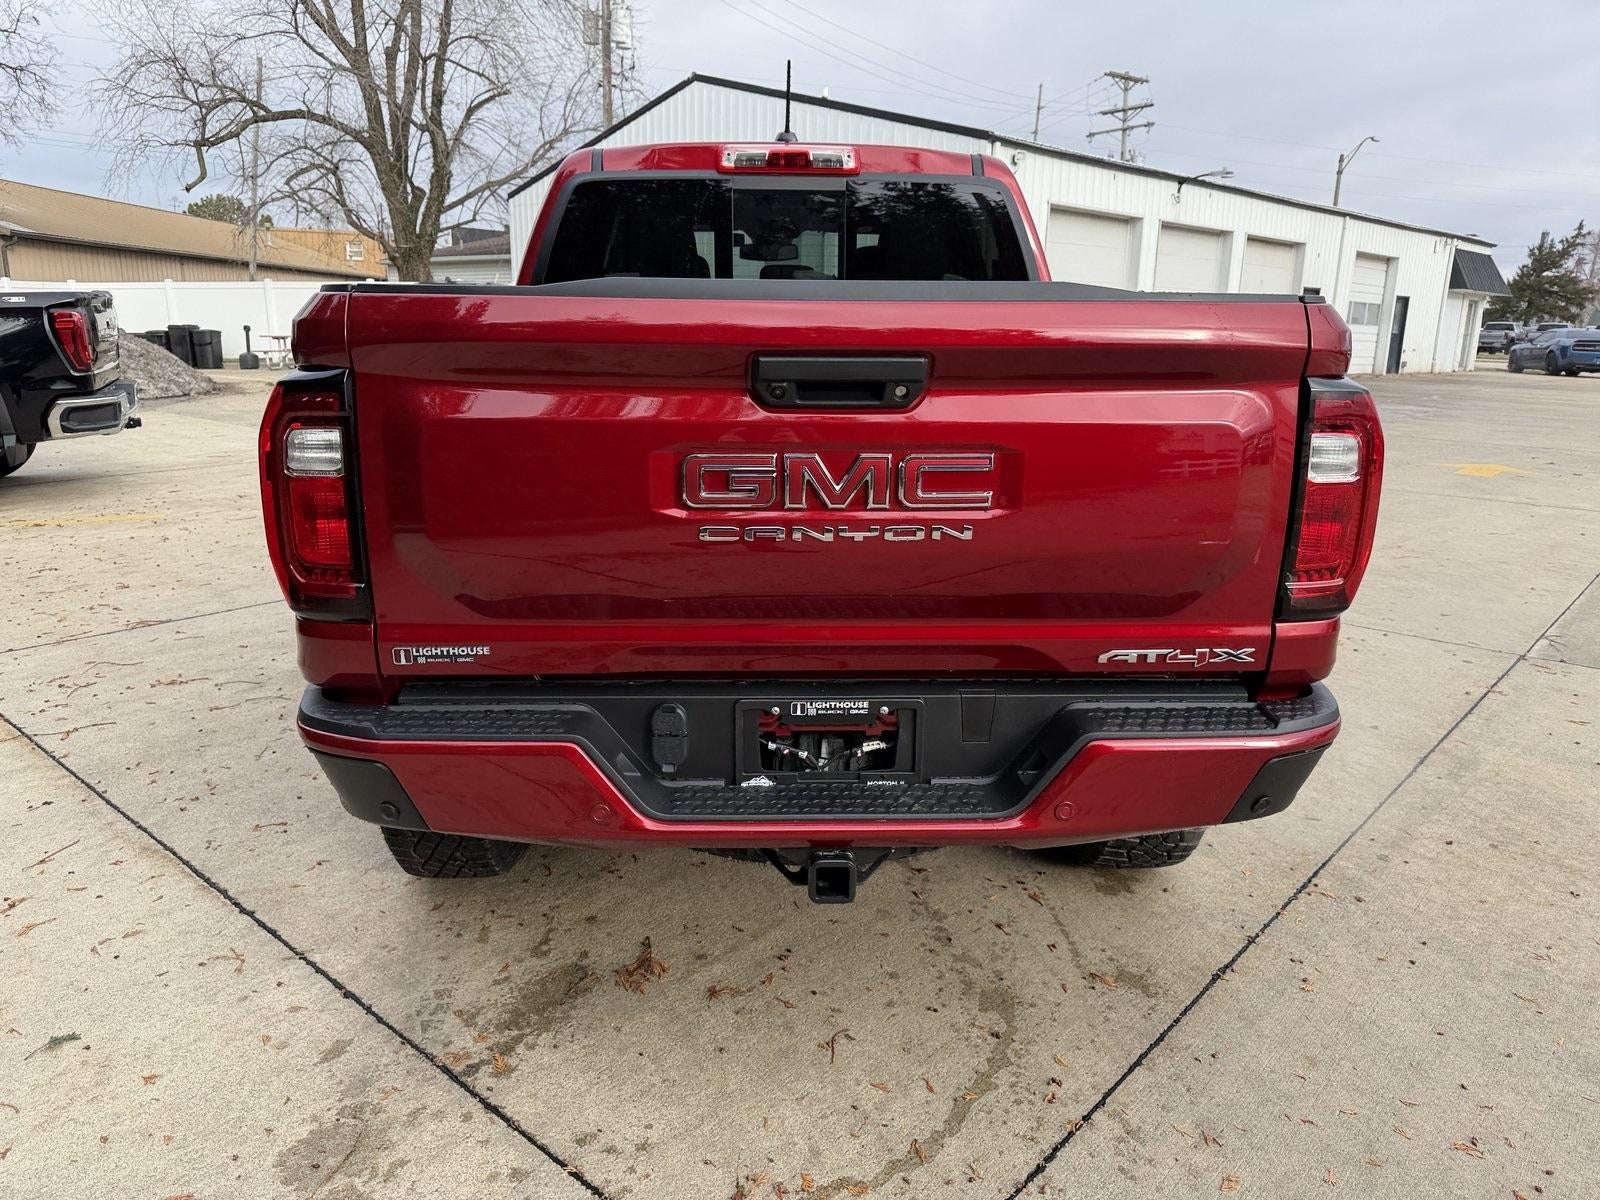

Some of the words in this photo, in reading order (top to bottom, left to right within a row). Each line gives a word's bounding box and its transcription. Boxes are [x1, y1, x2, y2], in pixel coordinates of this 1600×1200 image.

[682, 453, 994, 509] GMC
[699, 525, 973, 542] CANYON
[412, 647, 490, 655] LIGHTHOUSE
[1098, 648, 1255, 667] AT4X
[807, 701, 869, 709] LIGHTHOUSE
